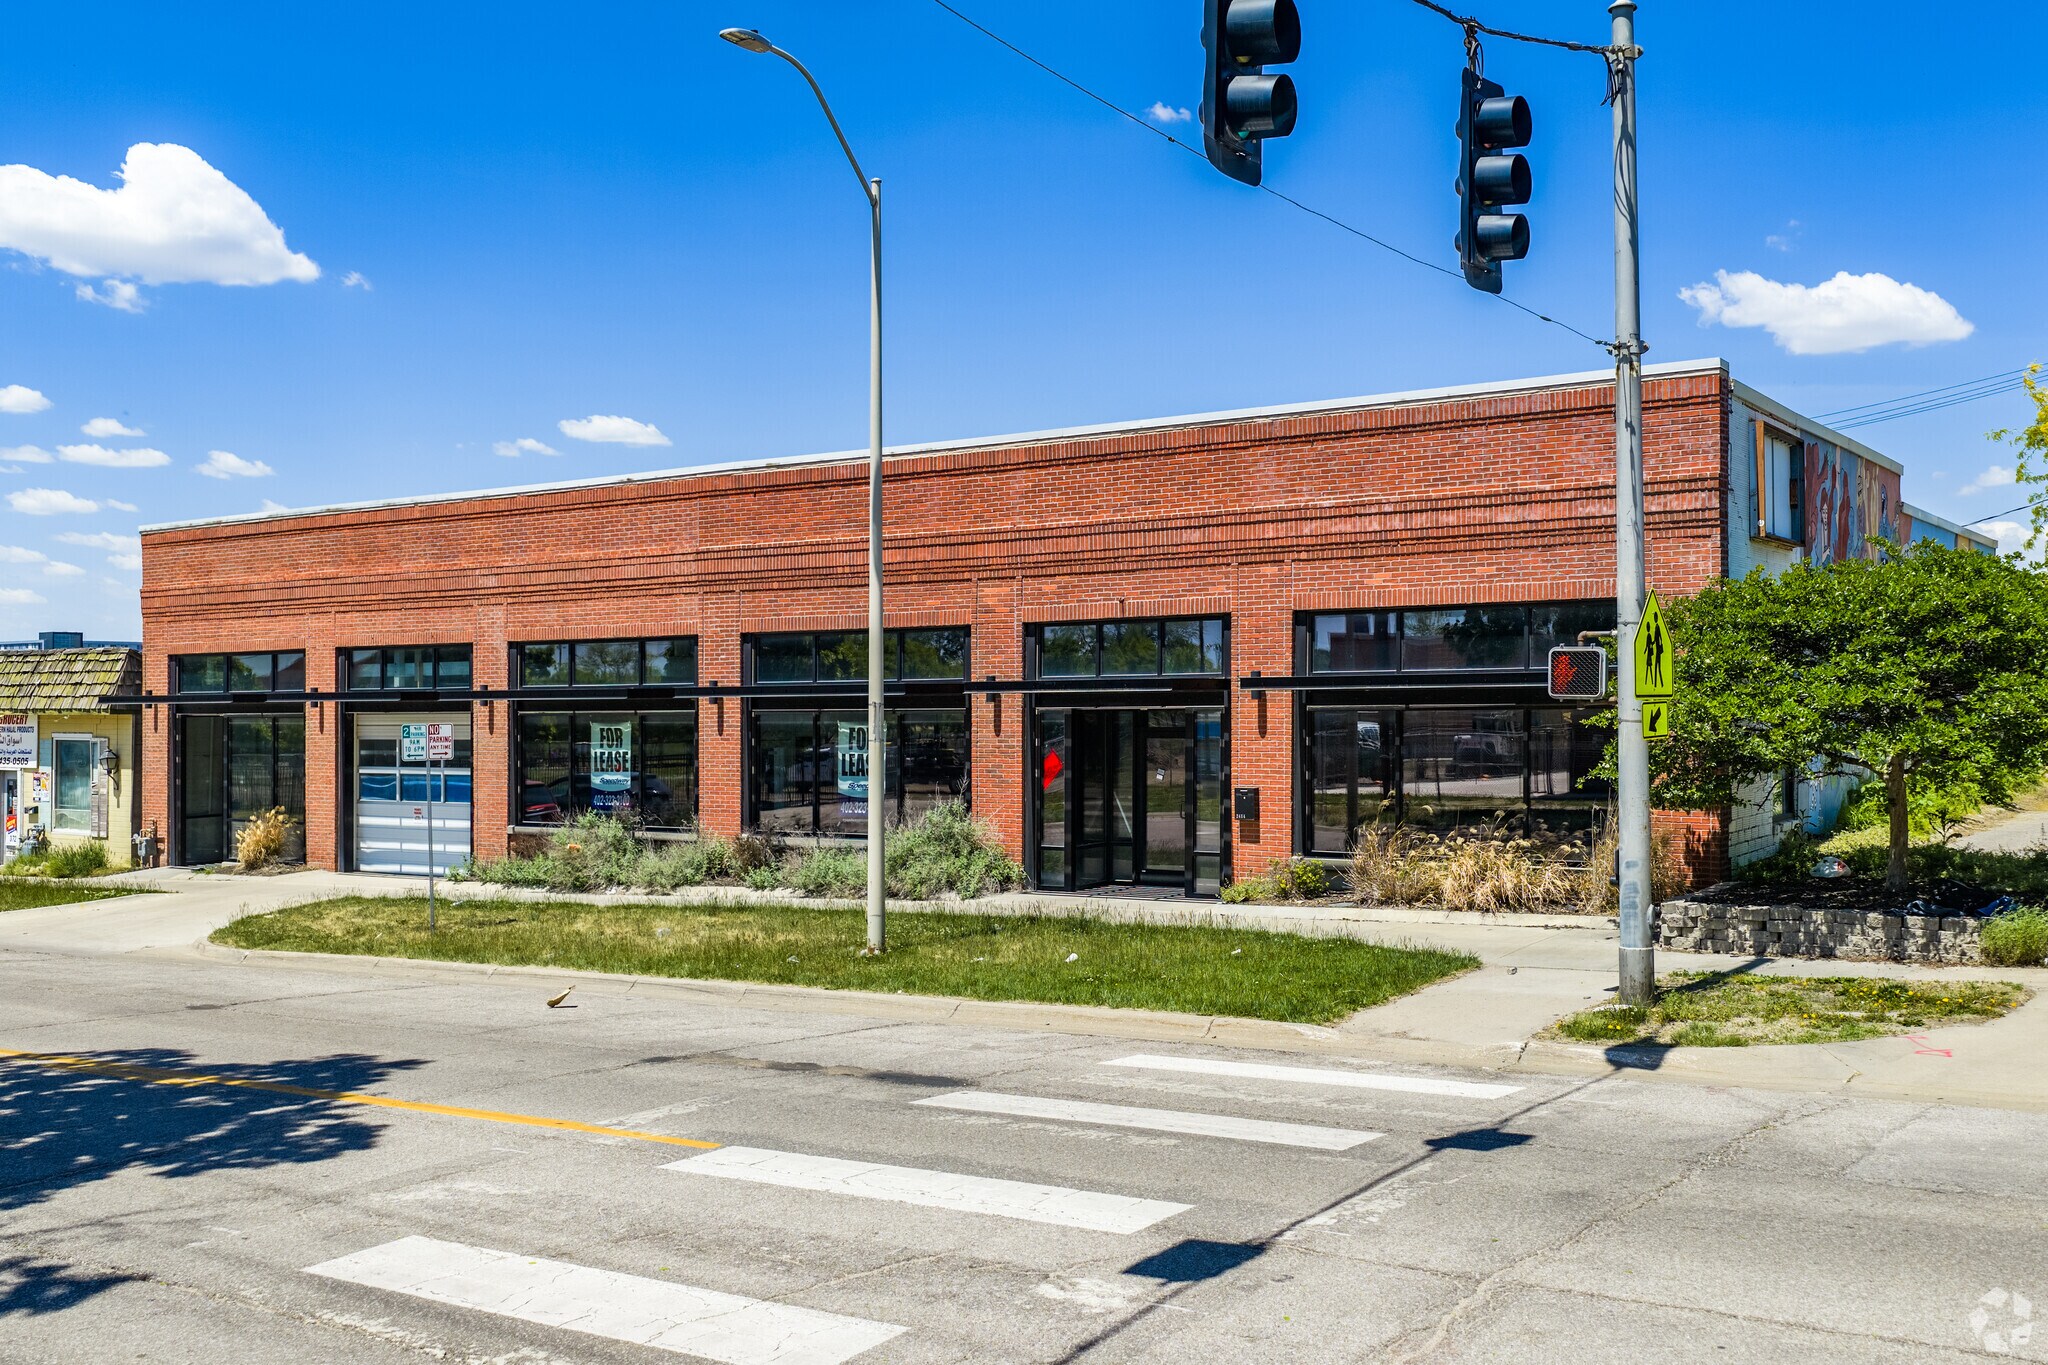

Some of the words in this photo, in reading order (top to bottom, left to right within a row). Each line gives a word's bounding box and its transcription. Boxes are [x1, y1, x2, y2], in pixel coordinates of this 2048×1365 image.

[403, 727, 409, 737] 2
[429, 725, 439, 734] NO
[599, 727, 623, 748] FOR
[848, 727, 869, 750] FO
[594, 750, 629, 772] LEASE
[841, 753, 869, 776] LEA
[840, 801, 869, 813] 402-323-
